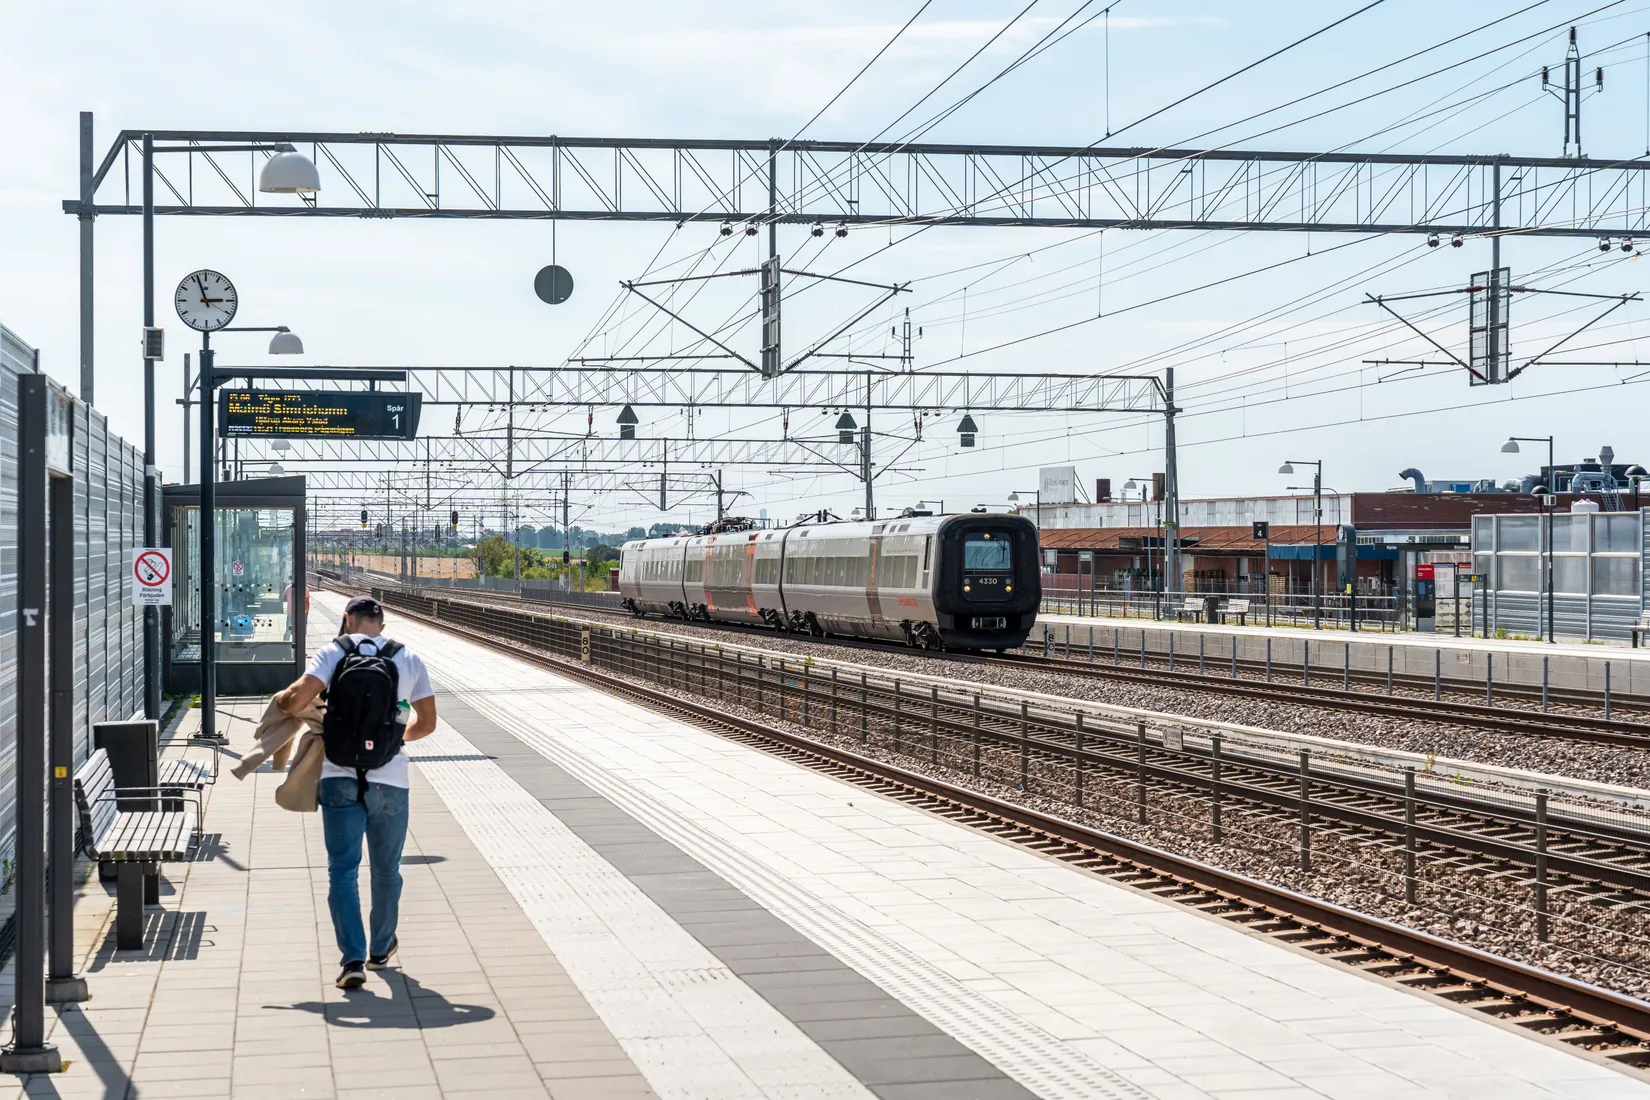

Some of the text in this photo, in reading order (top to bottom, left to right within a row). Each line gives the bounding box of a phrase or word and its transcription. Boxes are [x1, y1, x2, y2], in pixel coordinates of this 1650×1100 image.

[229, 403, 348, 415] Malmö Simrishamn
[386, 404, 404, 413] Spår
[391, 413, 399, 430] 1
[1257, 529, 1262, 537] 4
[978, 577, 998, 585] 4330
